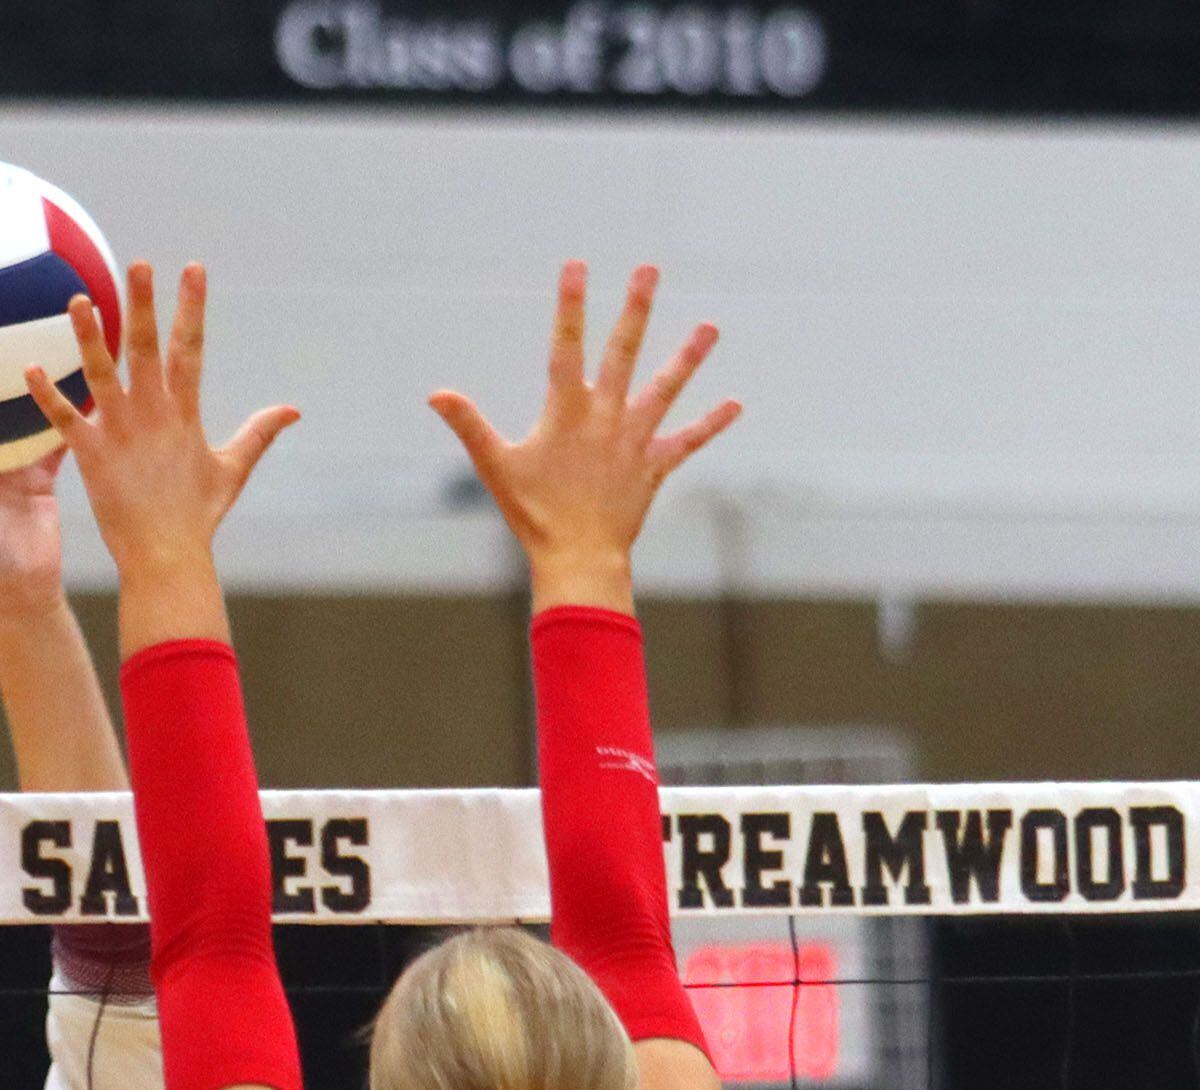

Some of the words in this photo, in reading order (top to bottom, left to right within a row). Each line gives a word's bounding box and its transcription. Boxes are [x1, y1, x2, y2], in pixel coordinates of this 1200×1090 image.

[274, 0, 498, 90] Class
[507, 1, 612, 92] of
[608, 5, 825, 96] 2010
[20, 818, 372, 916] SAES
[662, 806, 1187, 908] REAMWOOD
